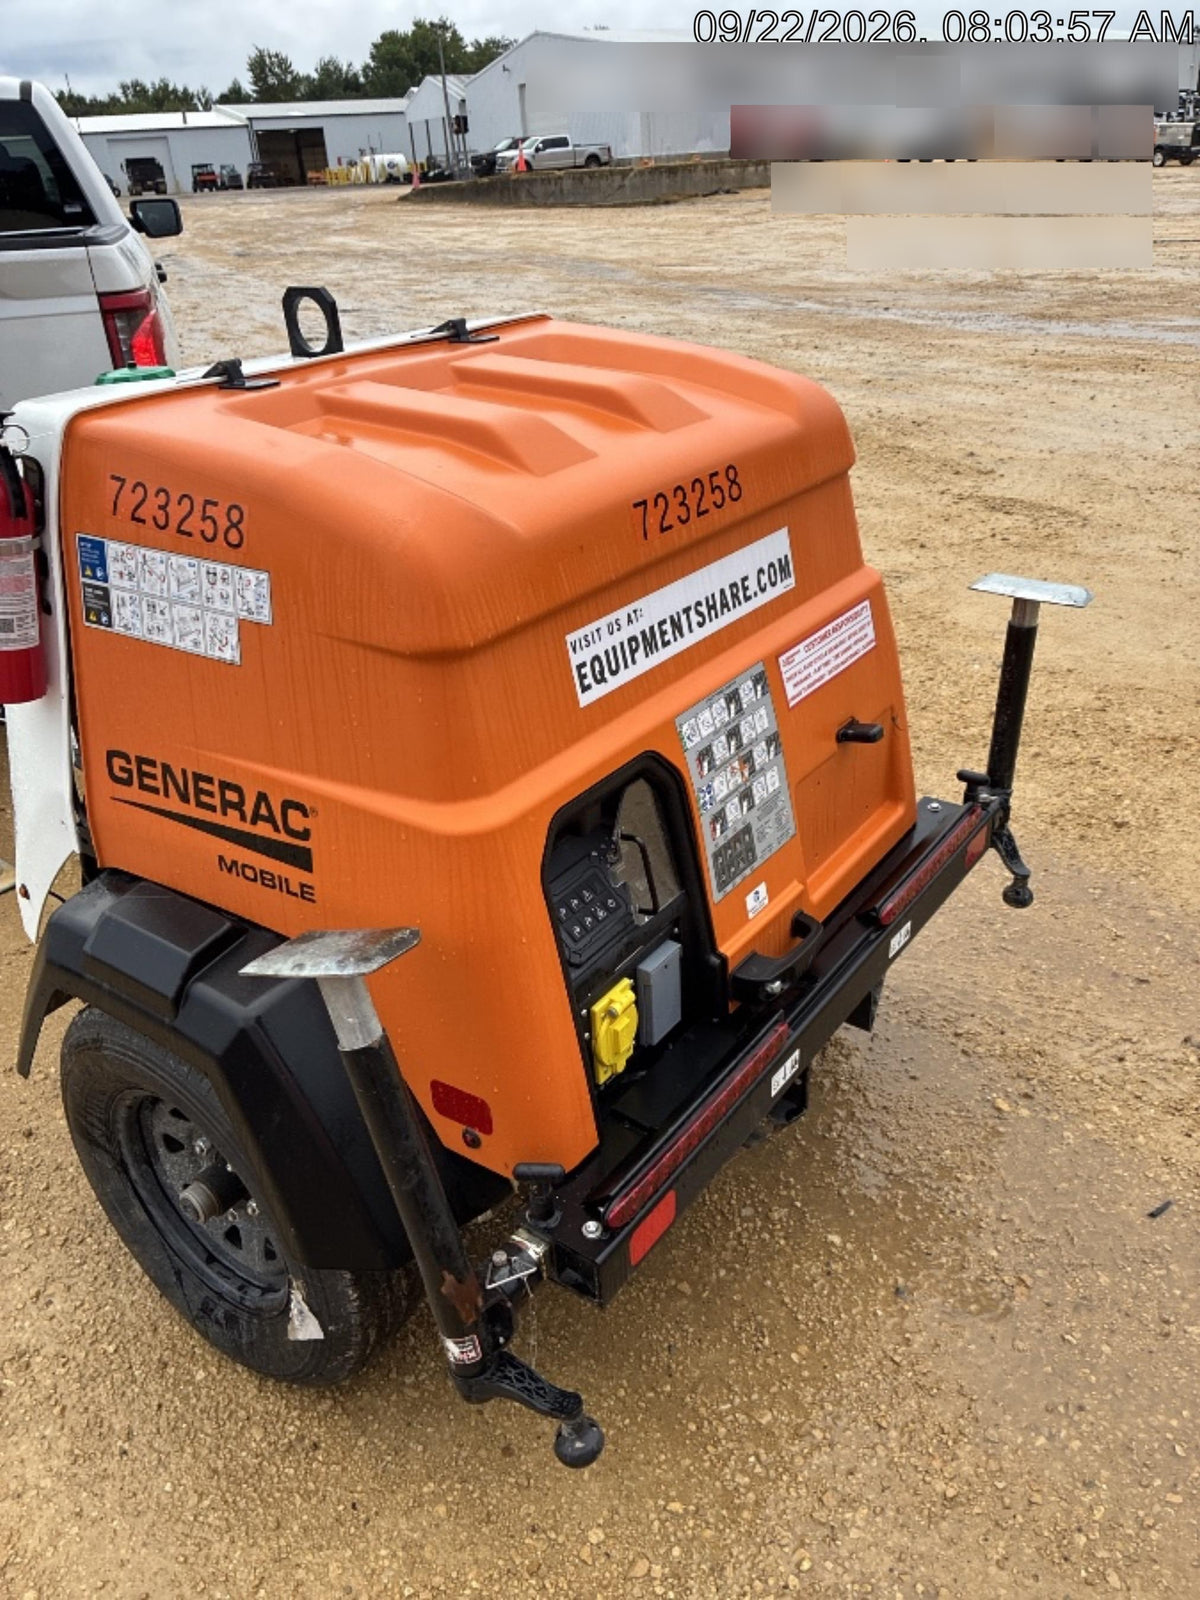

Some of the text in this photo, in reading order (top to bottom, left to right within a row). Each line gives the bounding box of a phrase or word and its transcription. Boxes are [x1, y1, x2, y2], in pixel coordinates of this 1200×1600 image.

[110, 474, 244, 549] 723258
[632, 464, 742, 540] 723258
[570, 607, 645, 655] VISIT US AT:
[575, 554, 792, 693] EQUIPMENTSHARE.COM
[106, 749, 312, 842] GENERAC
[217, 854, 317, 904] MOBILE
